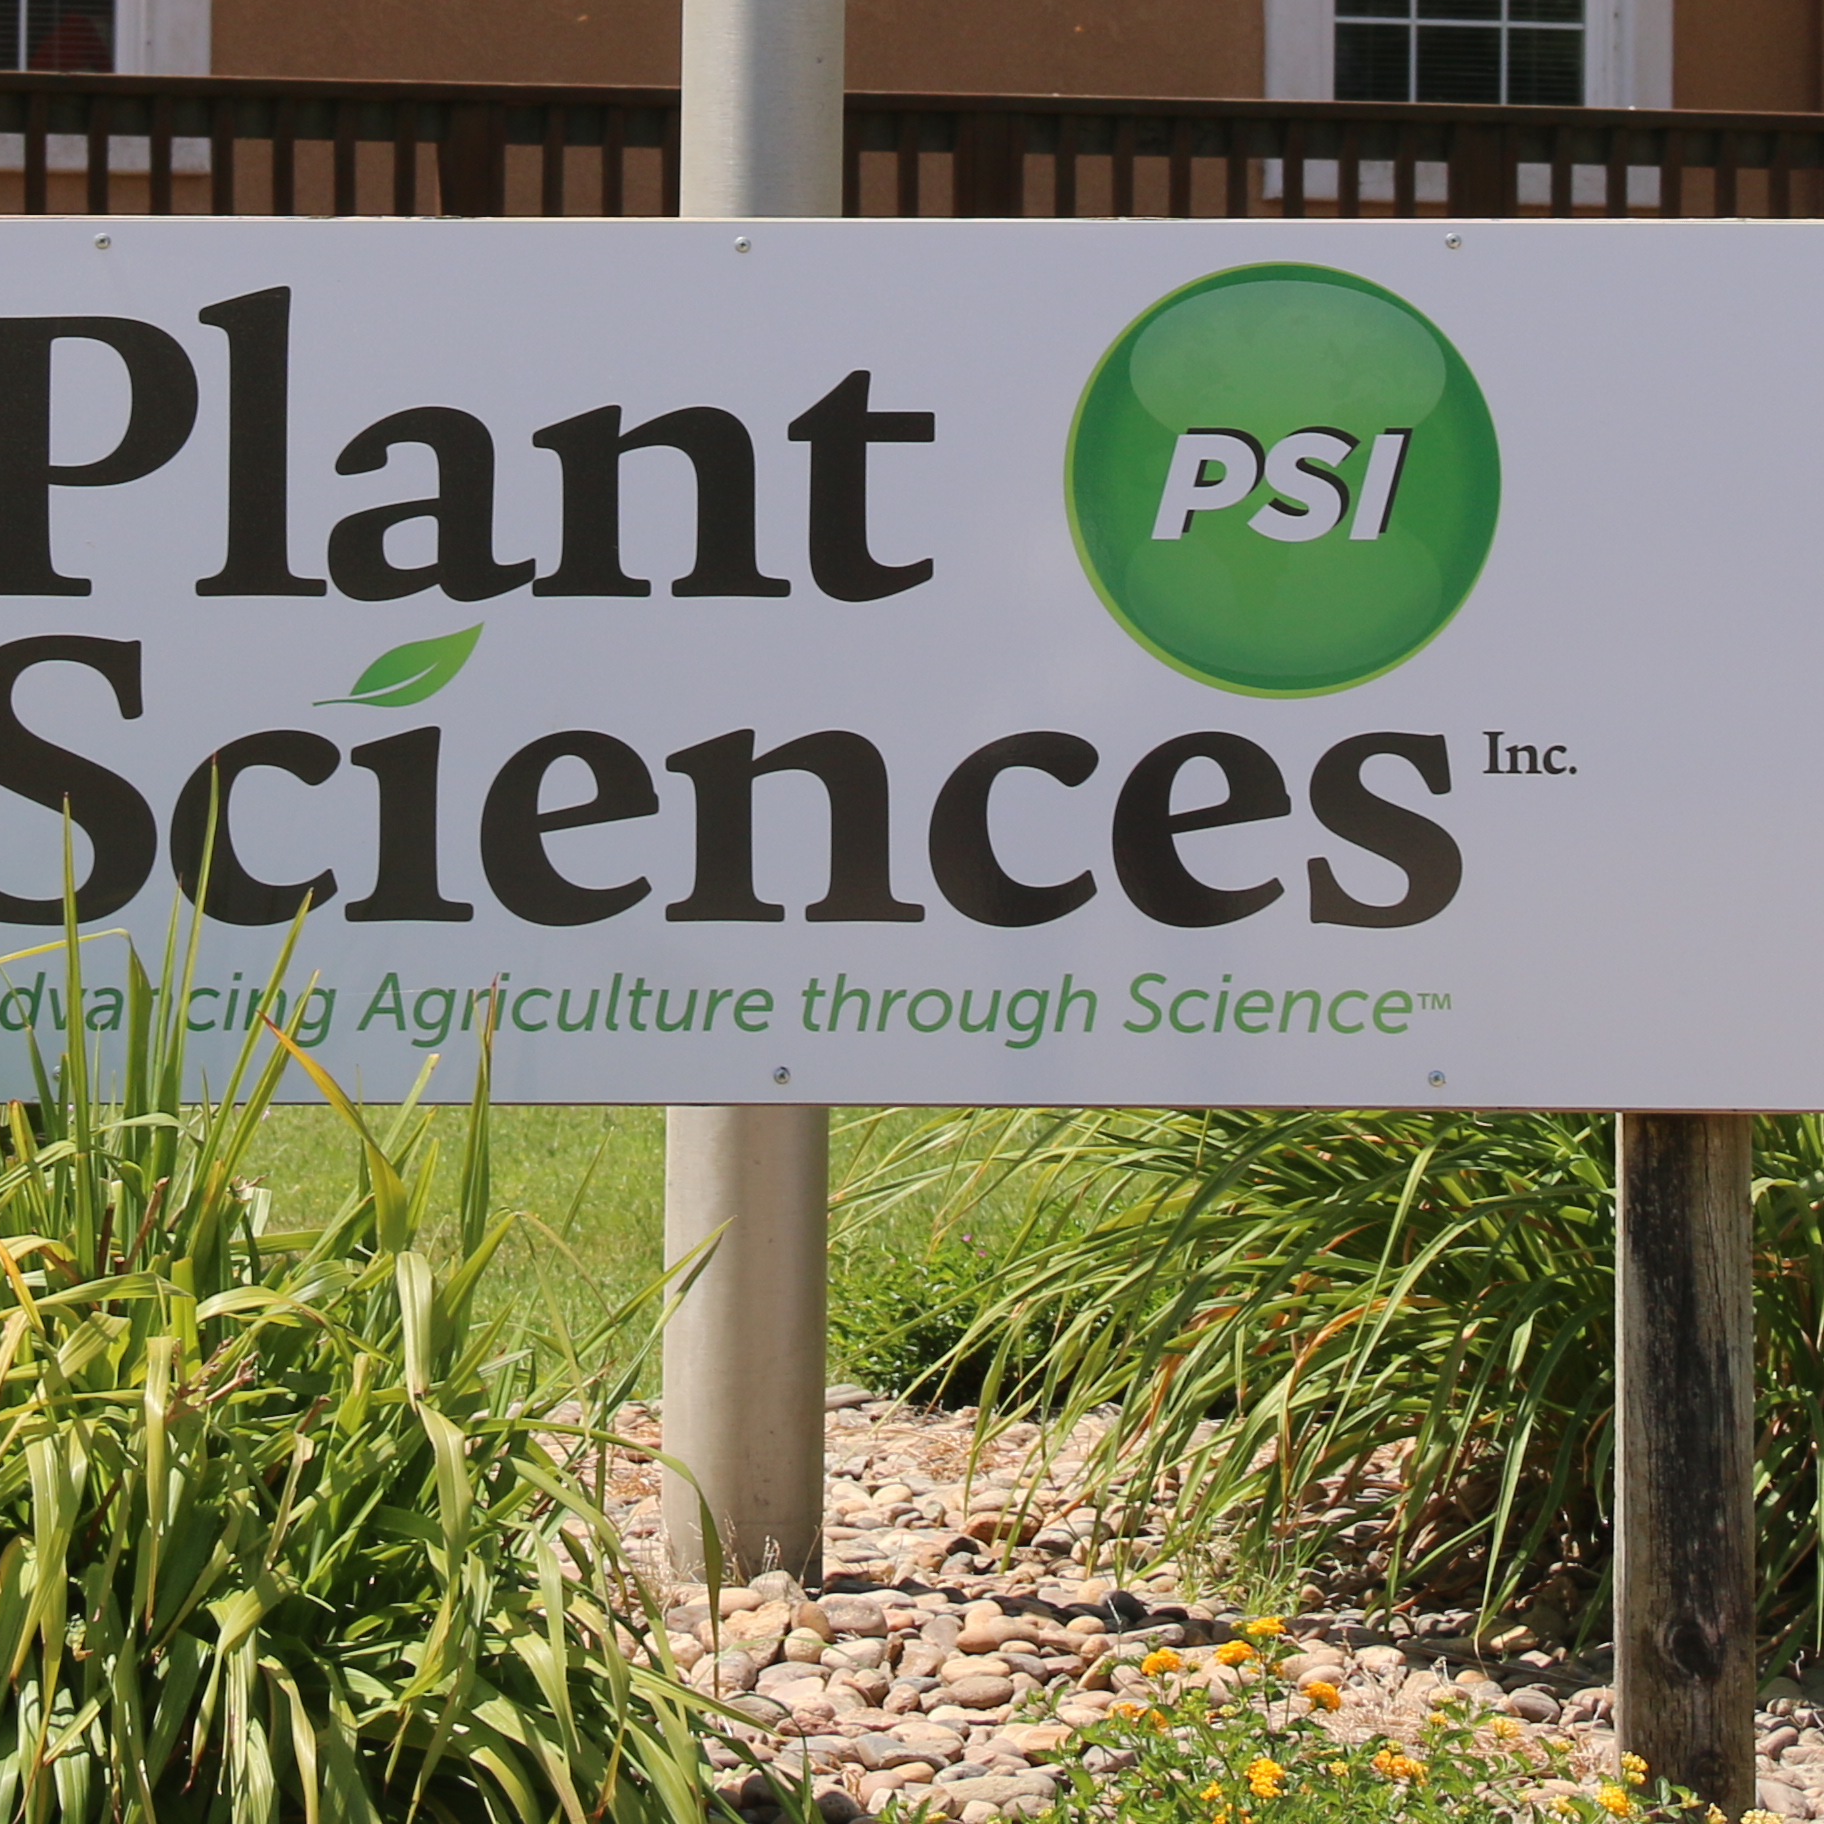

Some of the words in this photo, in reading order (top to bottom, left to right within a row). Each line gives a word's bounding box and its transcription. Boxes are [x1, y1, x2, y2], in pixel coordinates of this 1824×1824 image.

[1150, 425, 1414, 543] PSI
[1482, 730, 1578, 775] Inc.
[356, 971, 775, 1049] Agriculture
[800, 973, 1098, 1050] through
